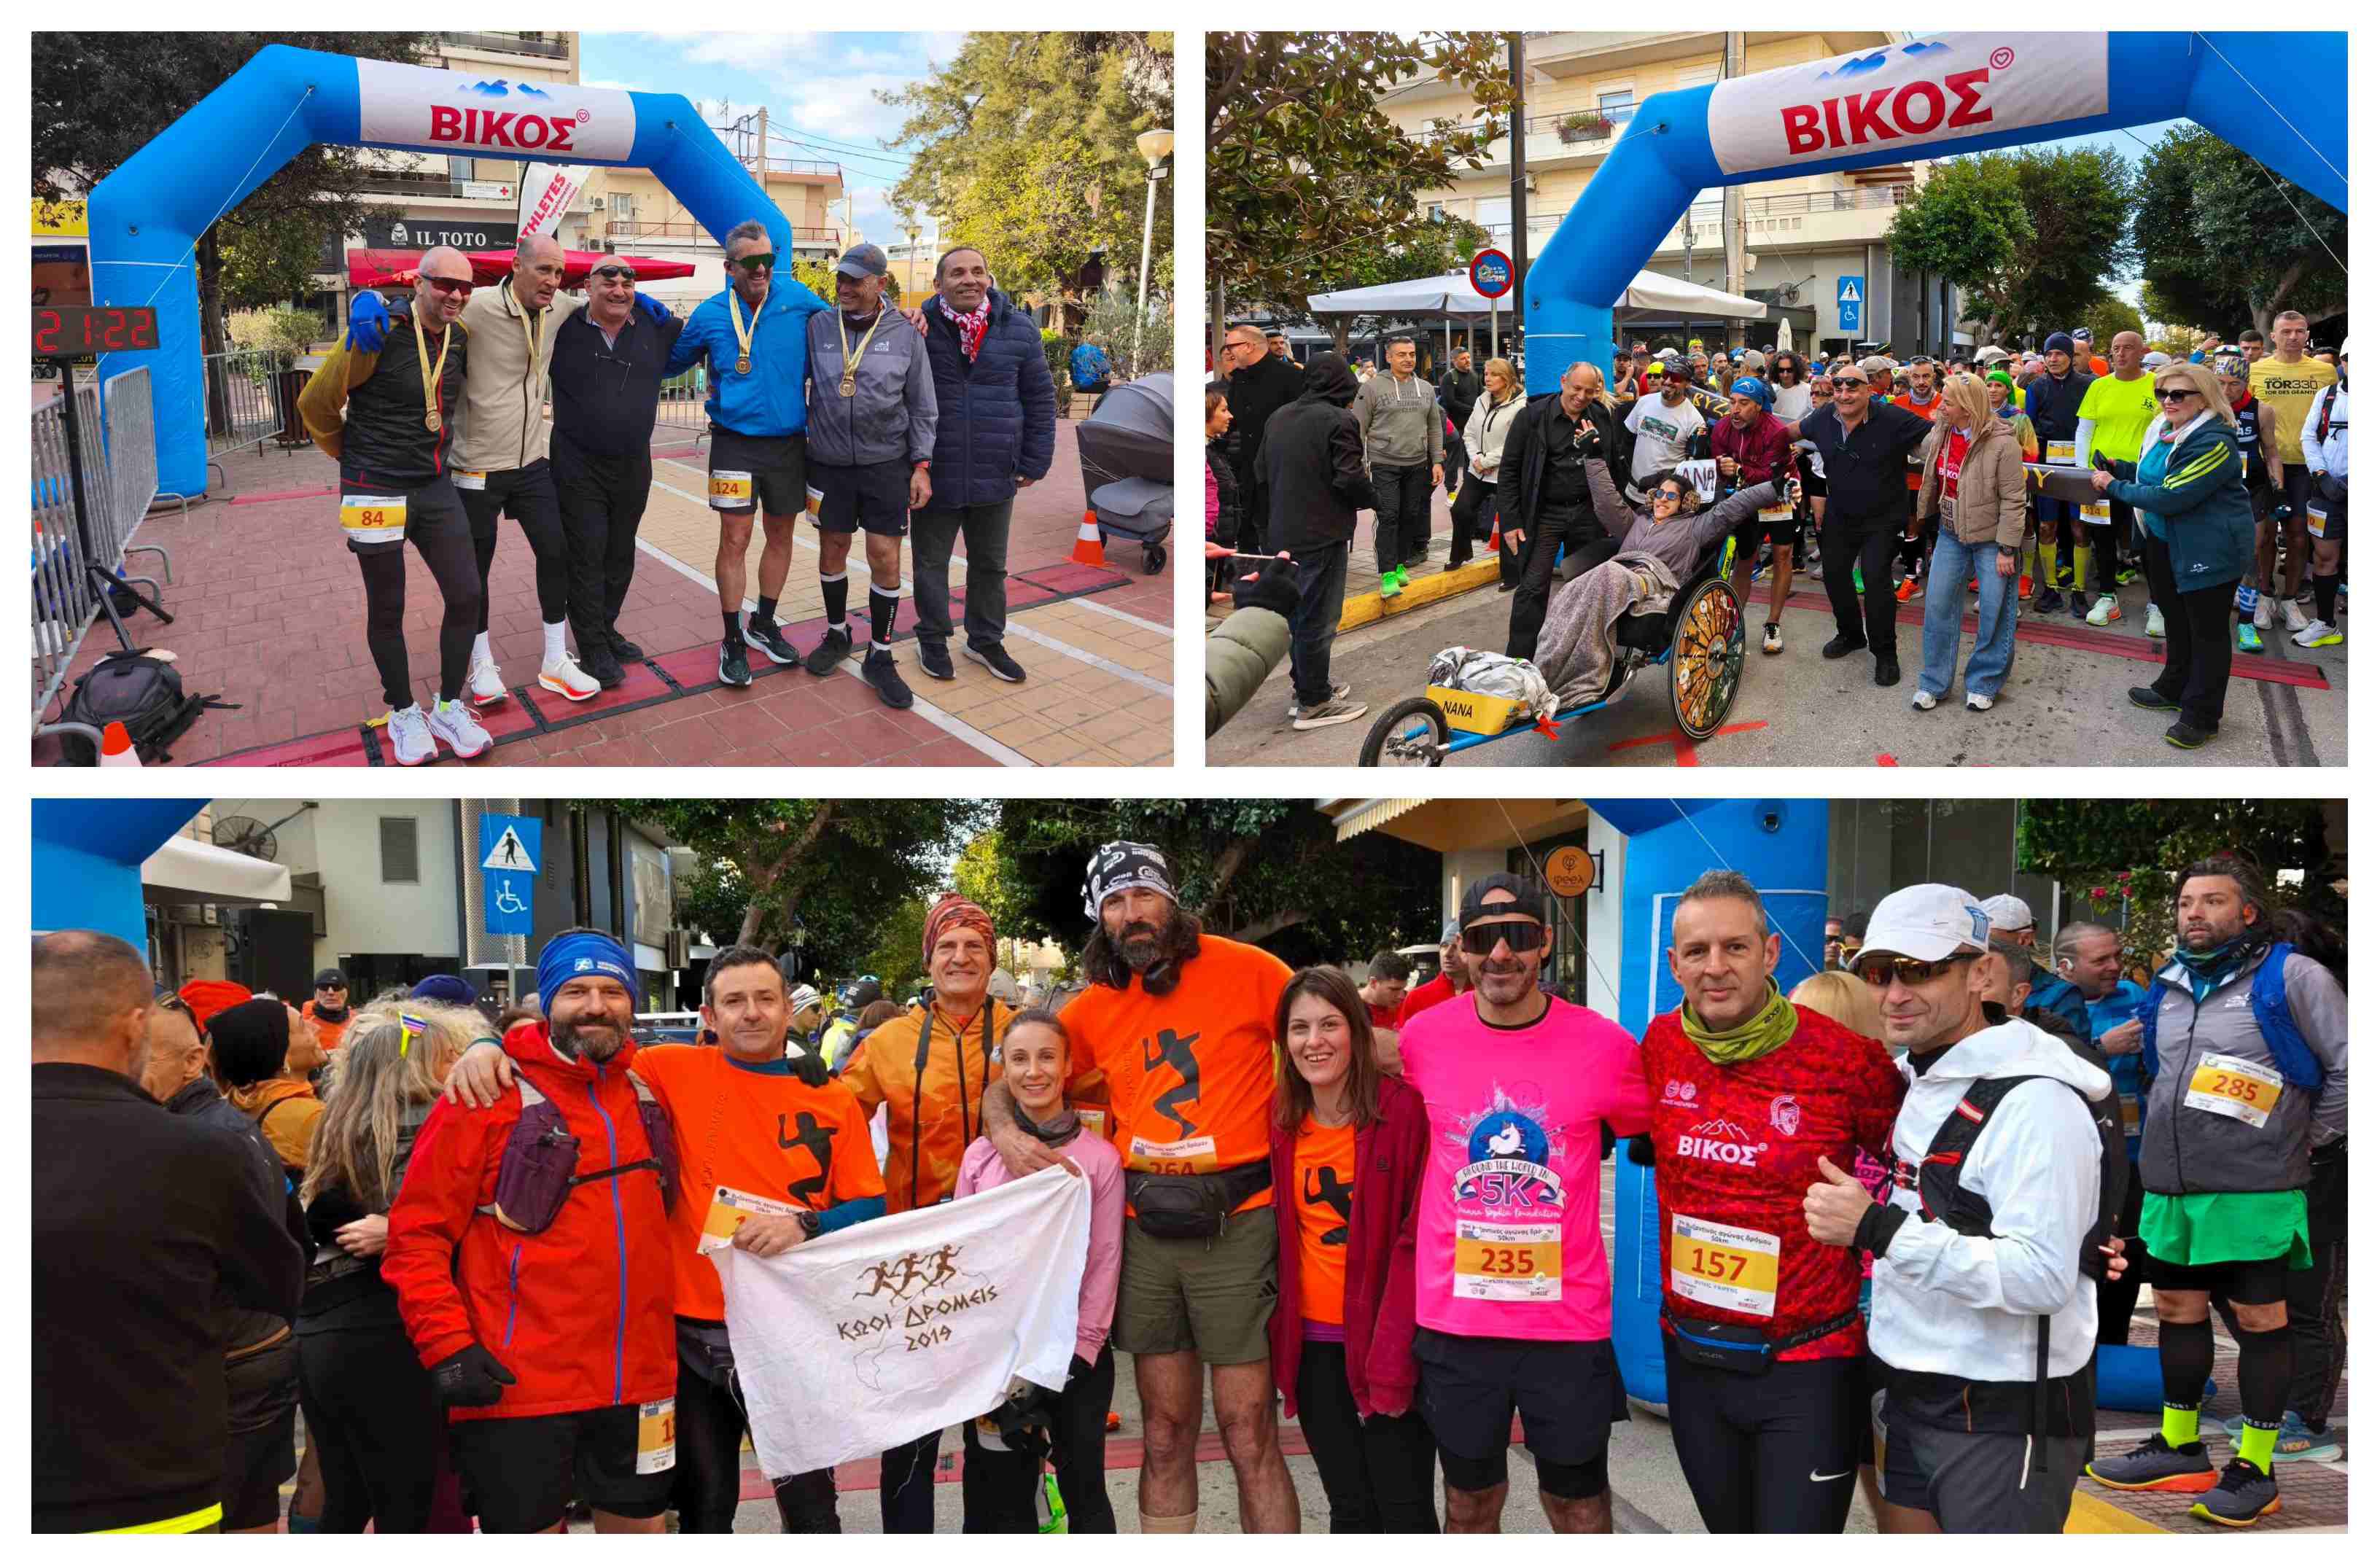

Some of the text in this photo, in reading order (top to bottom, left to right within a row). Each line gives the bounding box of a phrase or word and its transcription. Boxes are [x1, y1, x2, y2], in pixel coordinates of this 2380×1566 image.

[1781, 67, 1994, 155] ΒΙΚΟΣ
[429, 105, 576, 151] ΒΙΚΟΣ
[517, 172, 567, 243] THLETES
[416, 231, 486, 246] IL TOTO
[715, 483, 739, 494] 124
[361, 510, 384, 526] 84
[1442, 701, 1473, 717] NANA
[2212, 1075, 2258, 1101] 285
[1678, 1135, 1758, 1167] ΒΙΚΟΣ
[1480, 1172, 1533, 1207] 5K
[1481, 1248, 1534, 1274] 235
[1692, 1248, 1748, 1281] 157
[837, 1314, 892, 1341] ΚΩΟΙ
[905, 1325, 952, 1352] 2019
